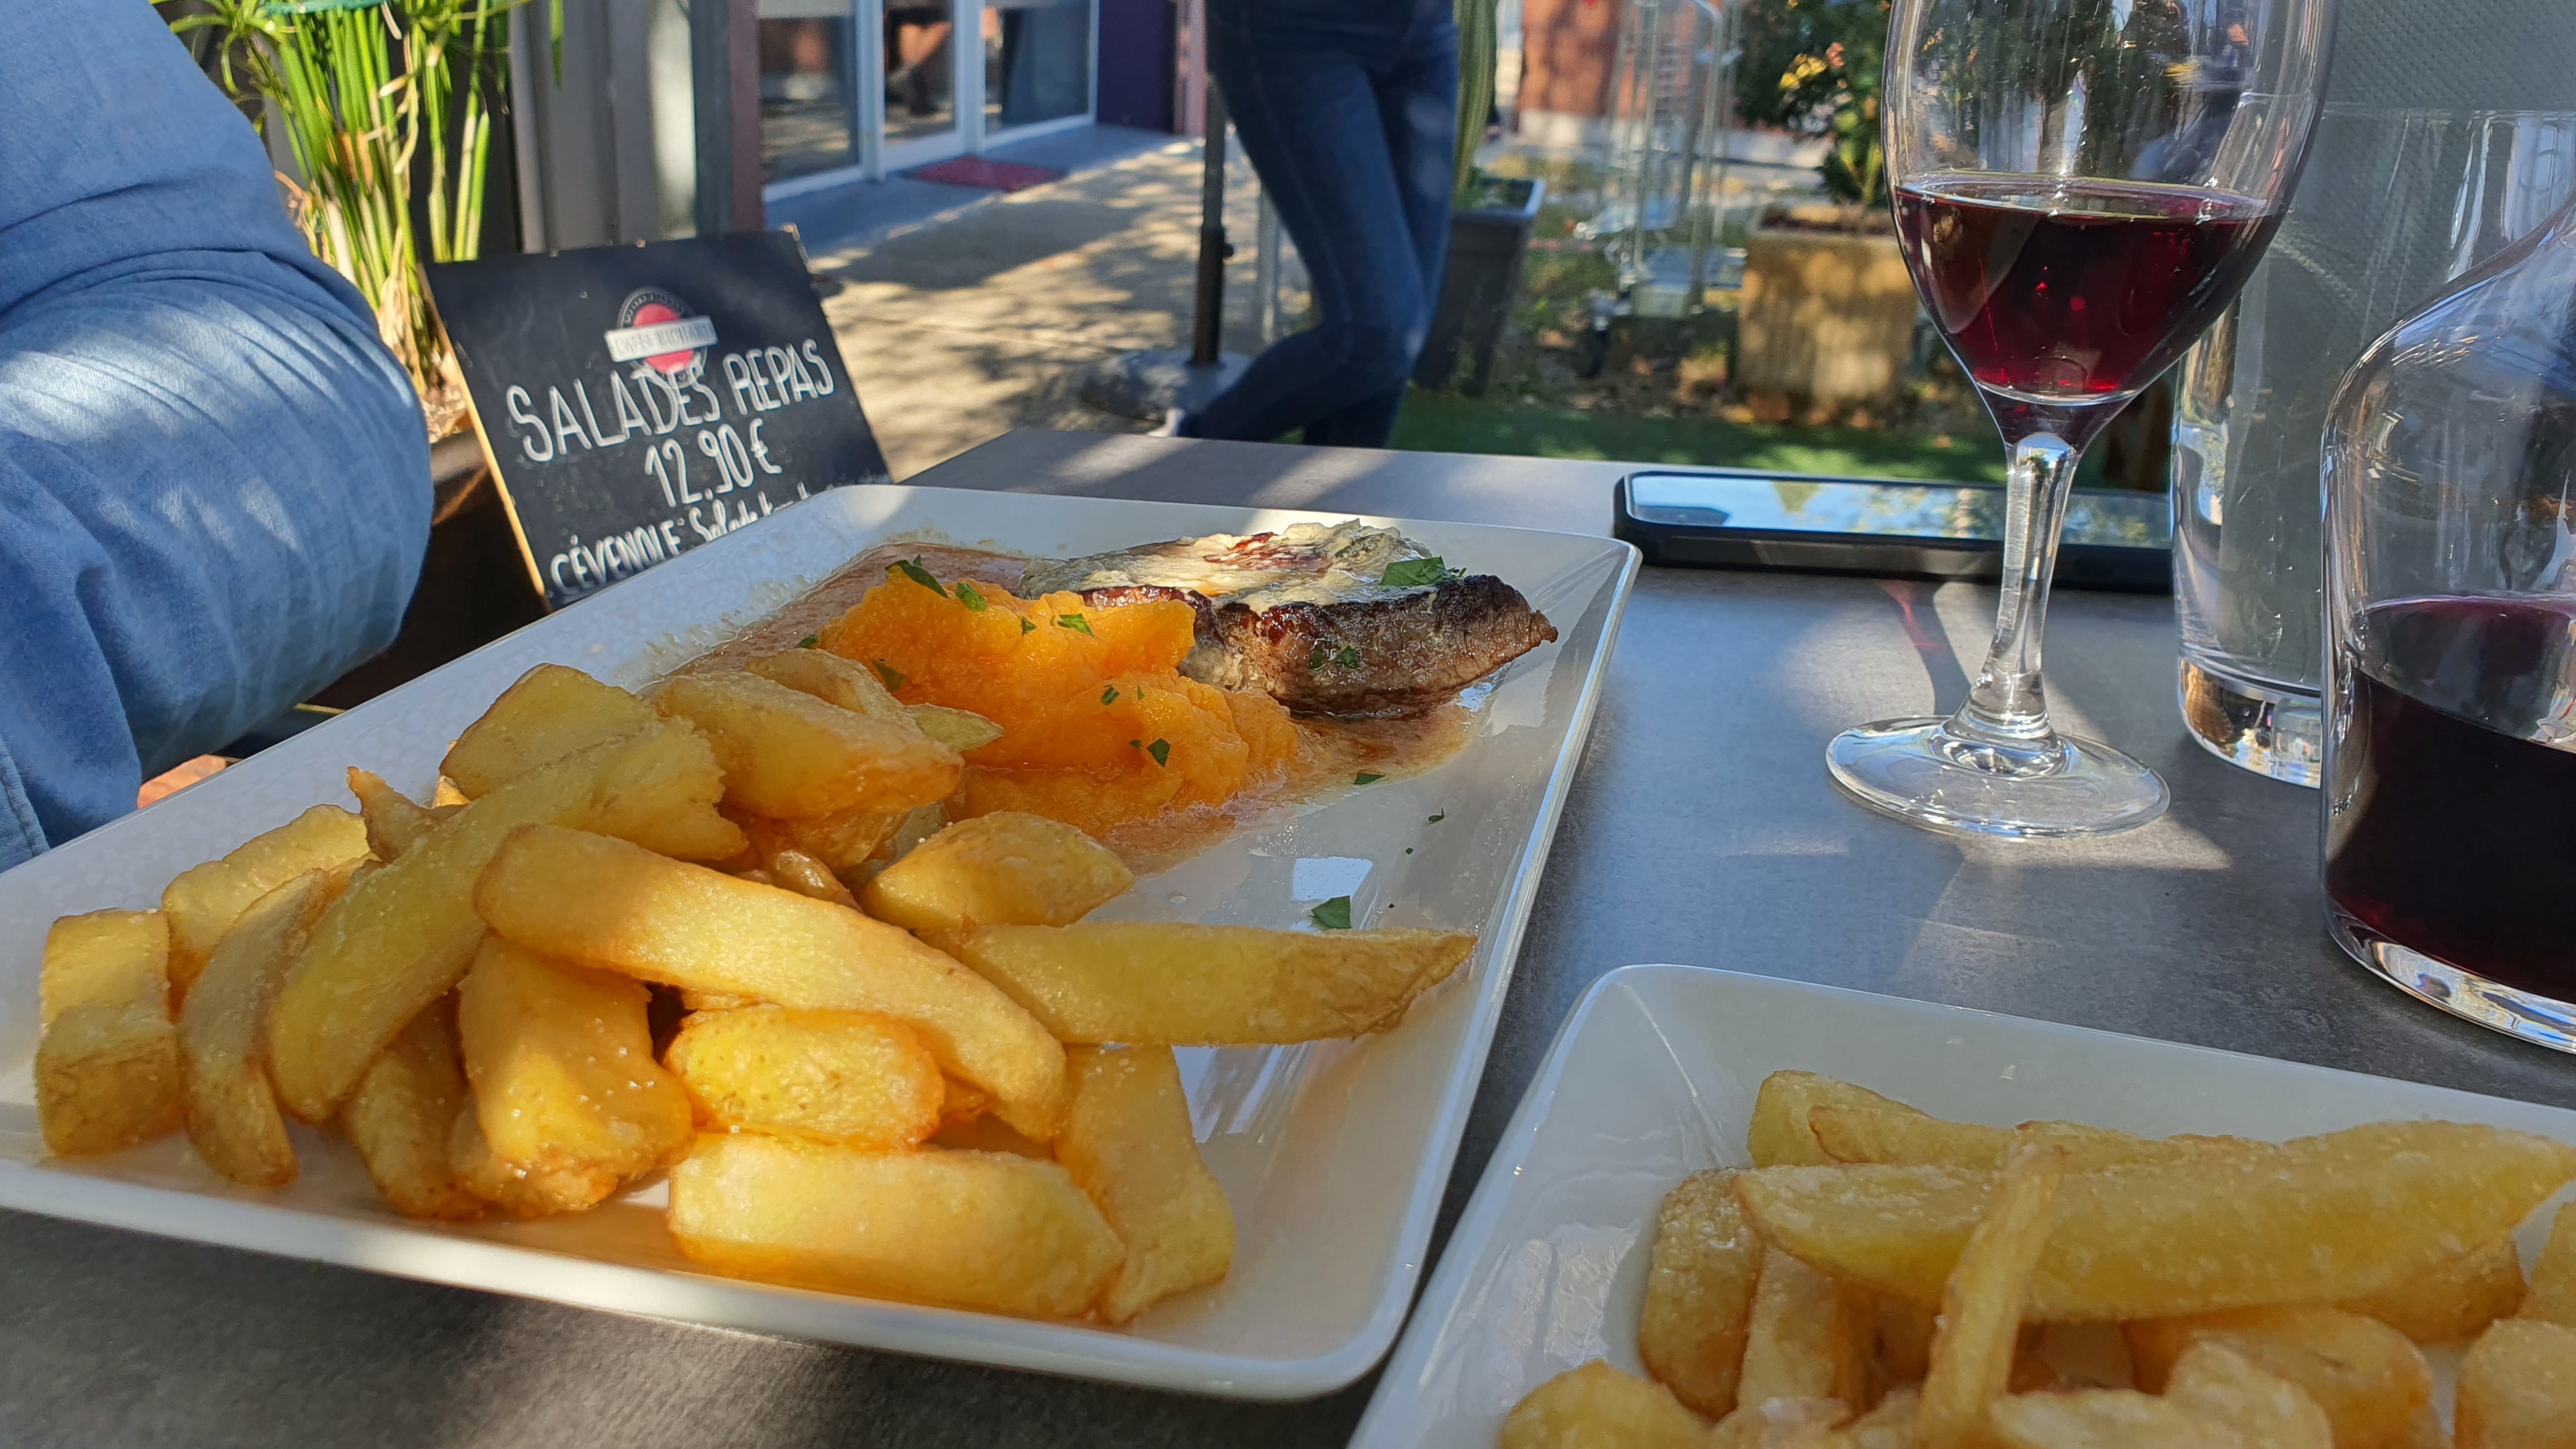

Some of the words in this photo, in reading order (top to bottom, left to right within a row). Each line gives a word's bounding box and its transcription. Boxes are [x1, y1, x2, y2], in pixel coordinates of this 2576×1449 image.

[506, 351, 721, 462] SALADES
[723, 339, 834, 415] REPAS
[644, 418, 783, 507] 12.90€
